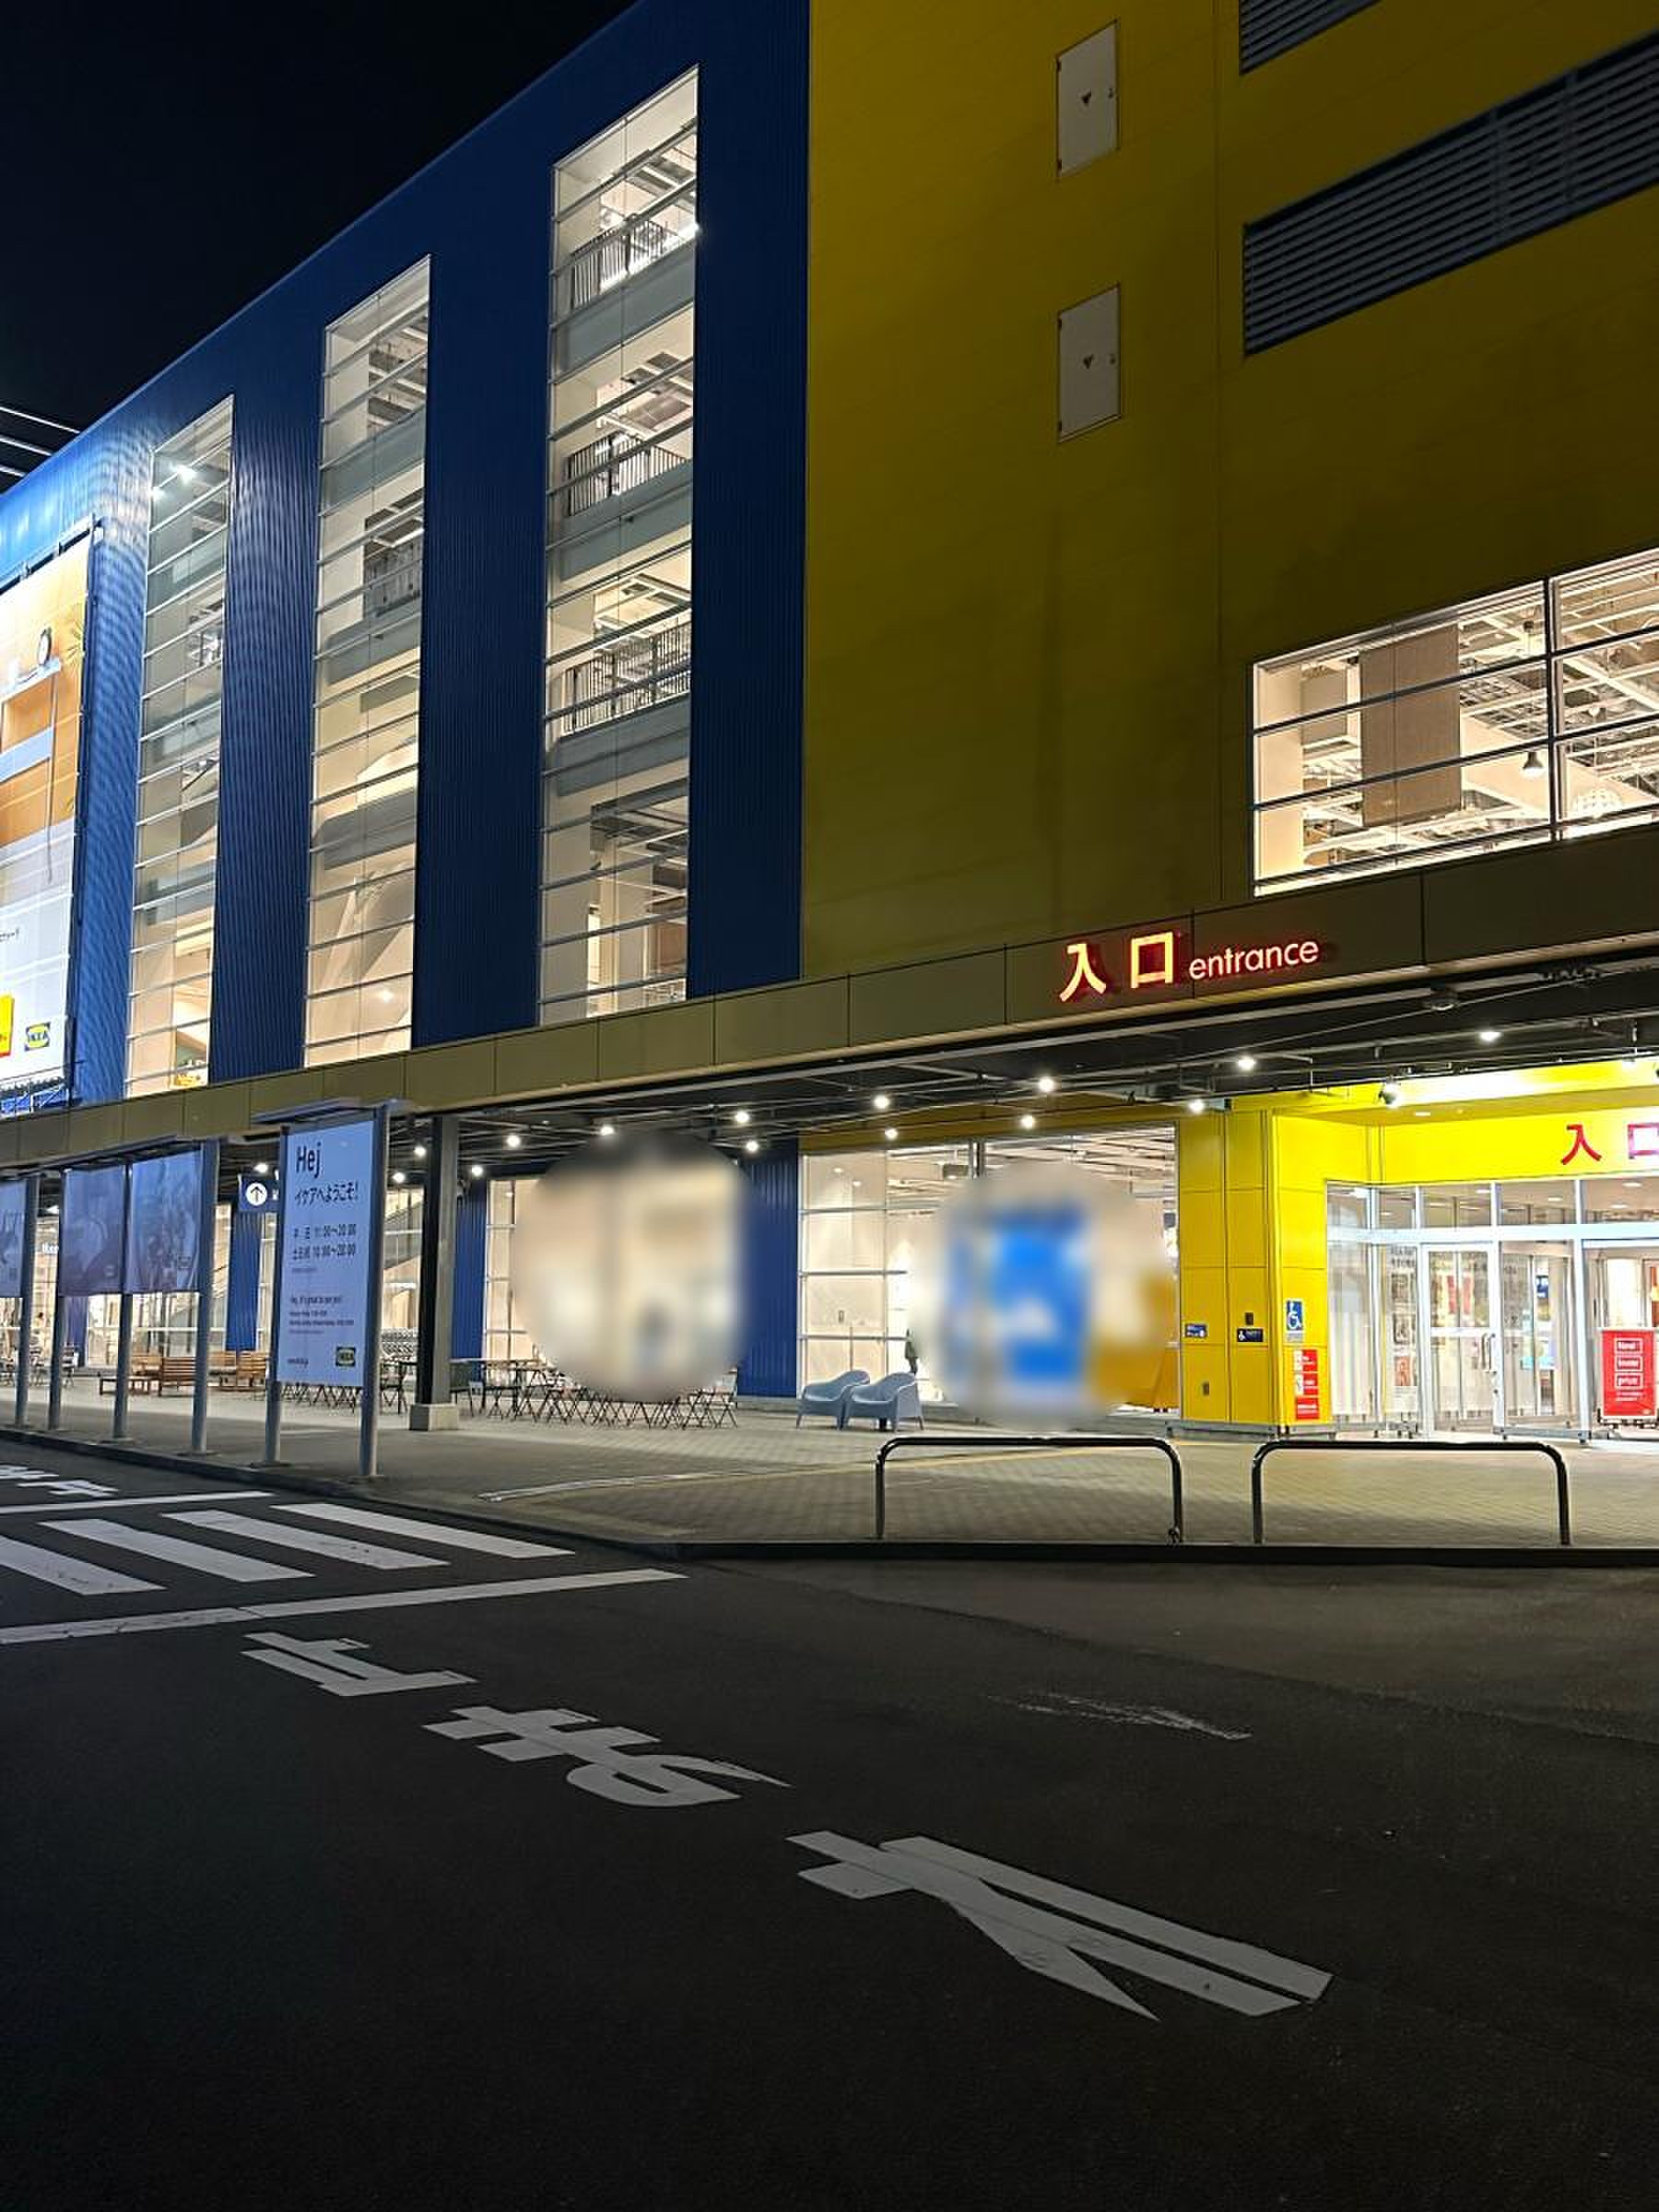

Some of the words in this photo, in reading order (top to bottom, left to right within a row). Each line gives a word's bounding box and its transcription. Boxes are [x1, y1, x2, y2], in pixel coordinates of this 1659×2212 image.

[1060, 932, 1173, 1002] 入口
[1188, 941, 1319, 980] entrance
[296, 1141, 322, 1179] Hej
[1560, 1123, 1659, 1165] 入口
[240, 1631, 1333, 2021] 止まれ
